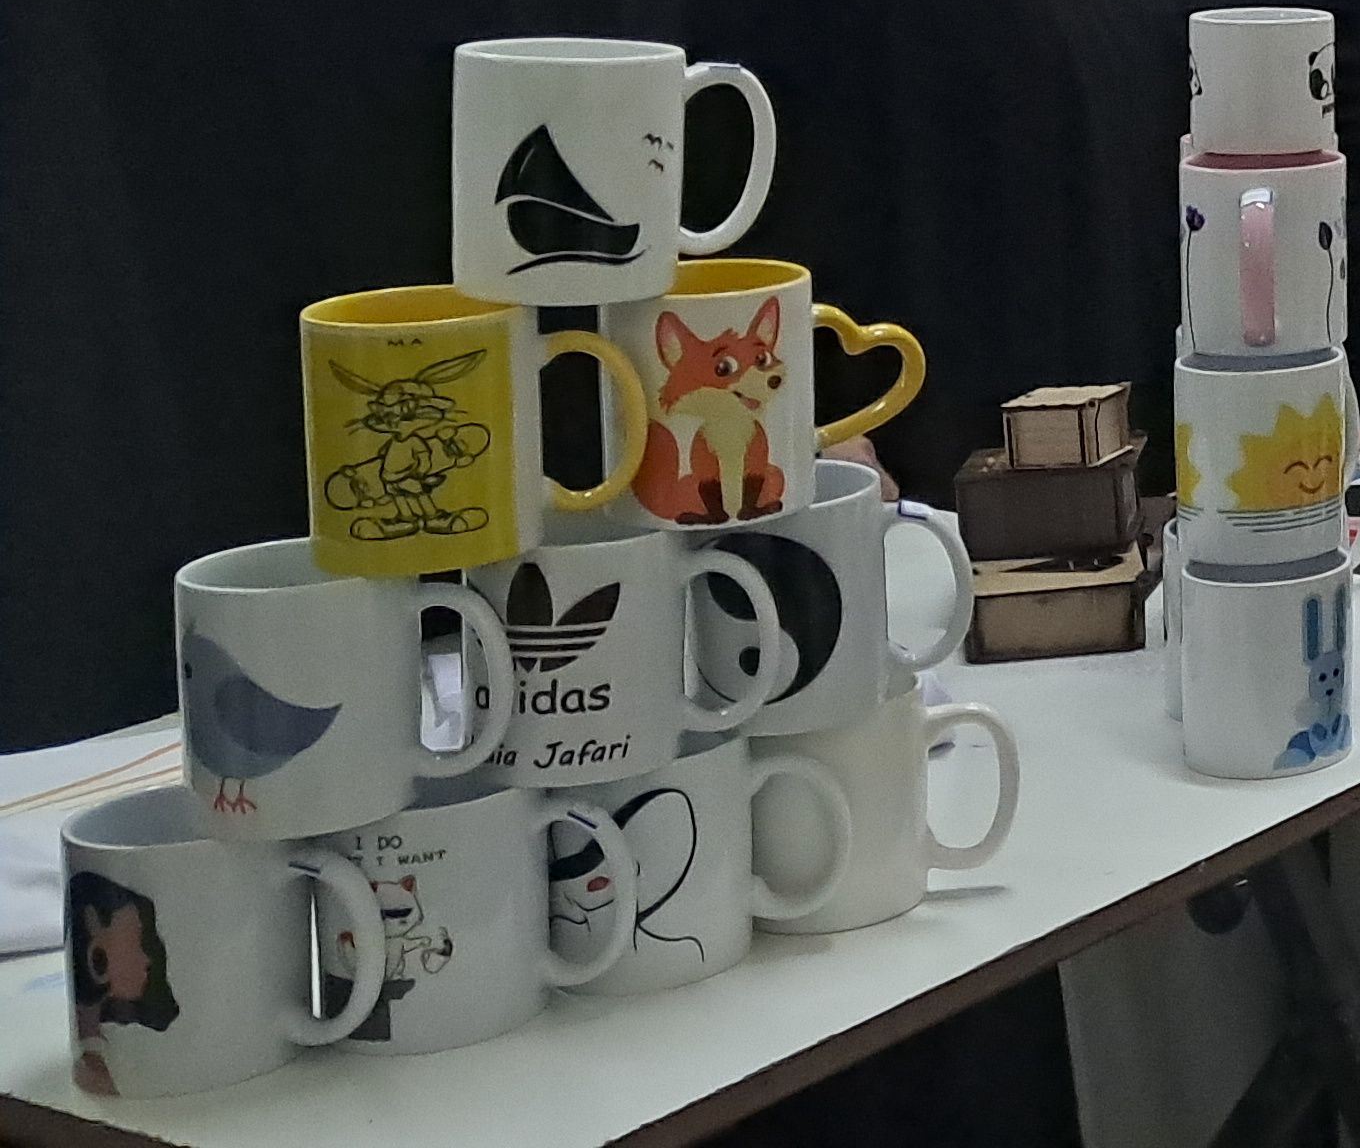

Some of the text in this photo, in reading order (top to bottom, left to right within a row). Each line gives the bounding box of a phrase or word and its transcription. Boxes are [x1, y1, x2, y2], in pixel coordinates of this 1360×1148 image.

[475, 678, 611, 715] aidas
[533, 735, 632, 769] Jafari
[377, 835, 403, 851] DO
[397, 848, 448, 866] WANT
